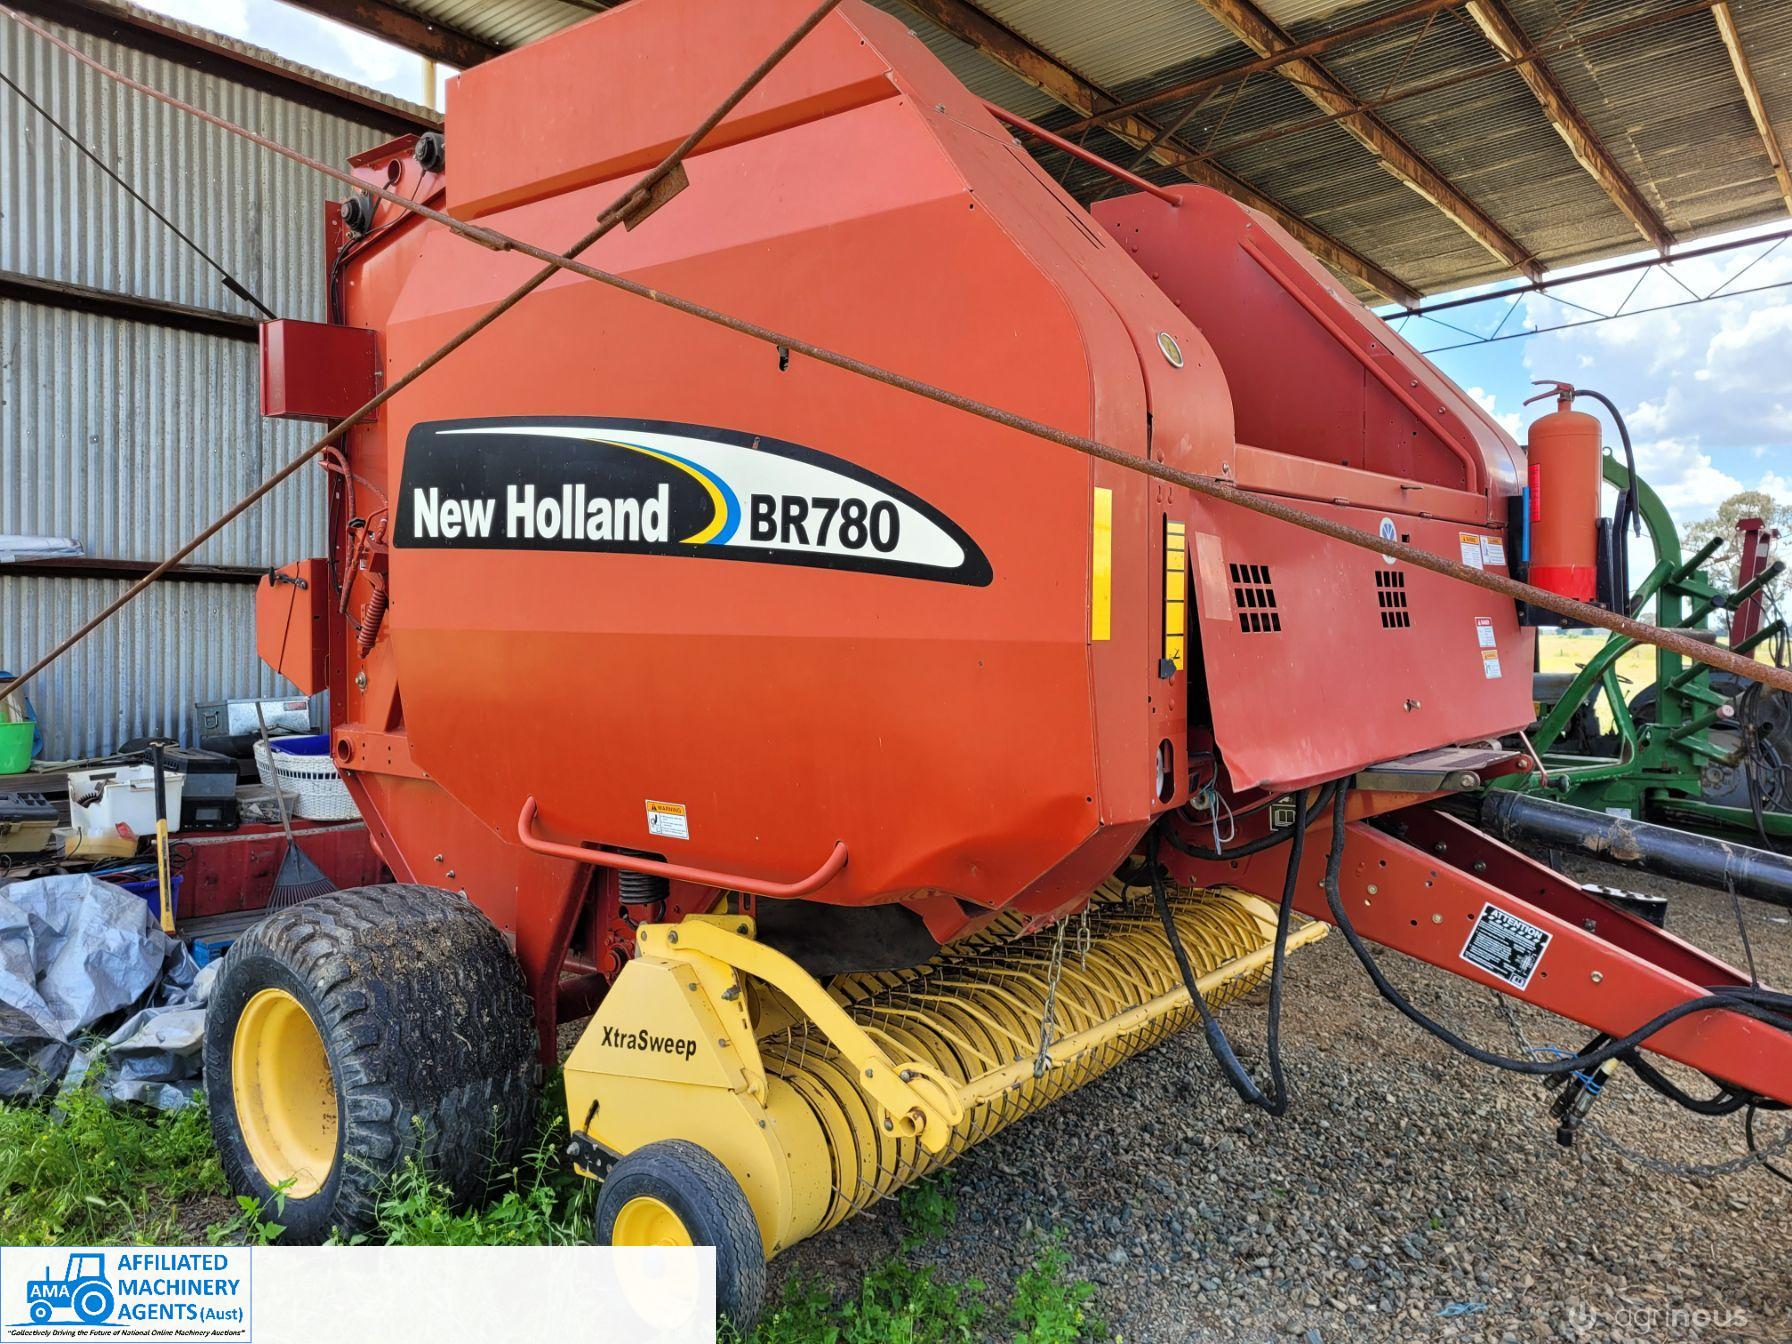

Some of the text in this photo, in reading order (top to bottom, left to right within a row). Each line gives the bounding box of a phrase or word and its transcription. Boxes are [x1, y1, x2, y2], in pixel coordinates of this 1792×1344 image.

[413, 483, 670, 544] New Holland
[749, 493, 901, 553] BR780
[1491, 909, 1543, 938] ATTENTION
[601, 1026, 697, 1062] XtraSweep
